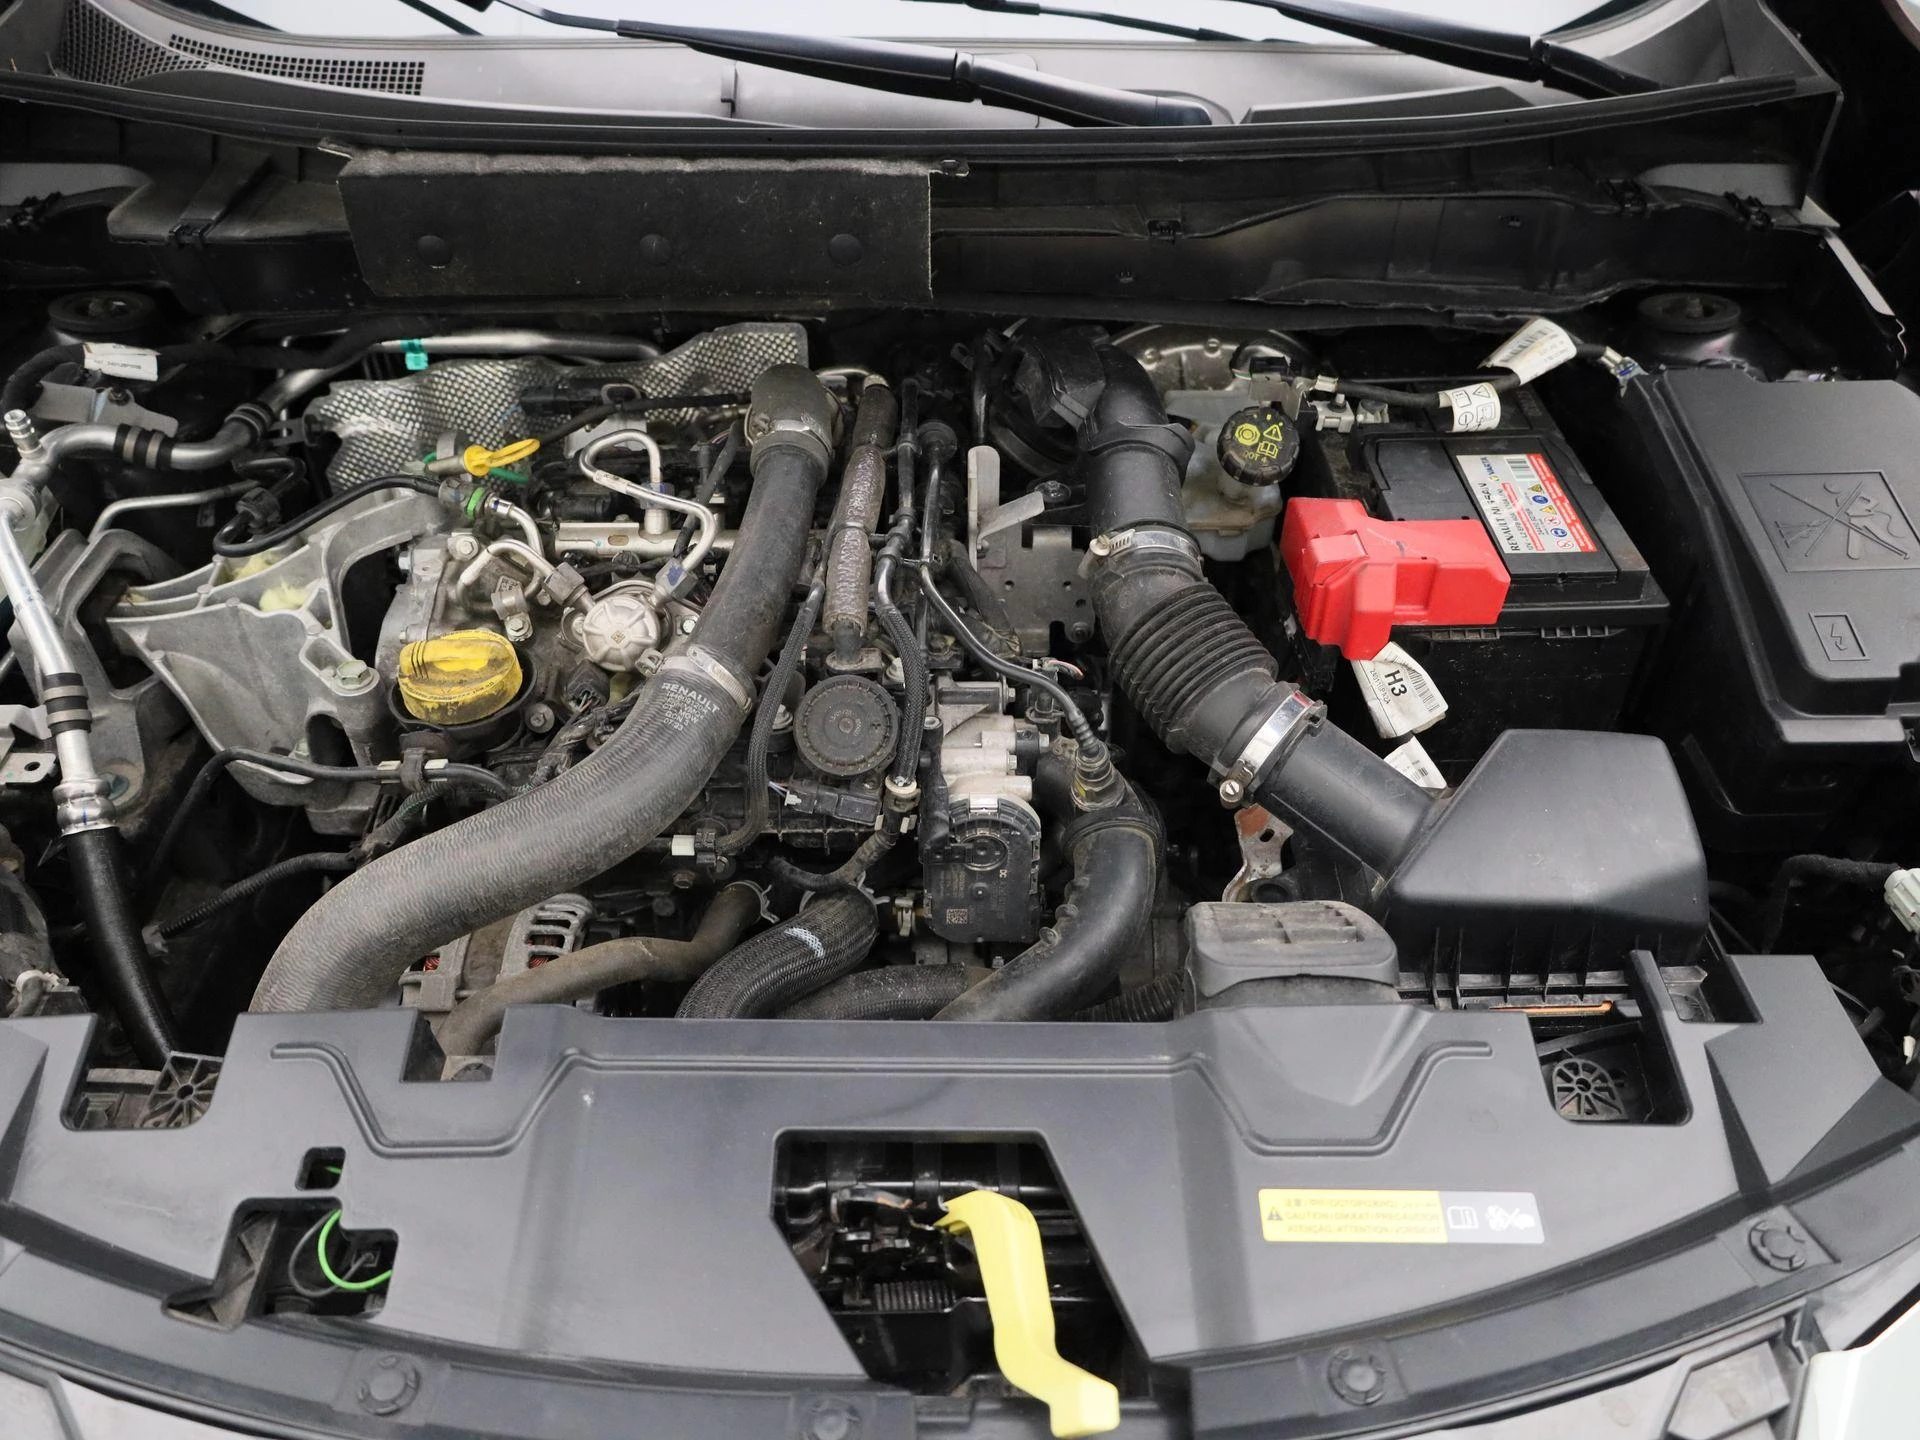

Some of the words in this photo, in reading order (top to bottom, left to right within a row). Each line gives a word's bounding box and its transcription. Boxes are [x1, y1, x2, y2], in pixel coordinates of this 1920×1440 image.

[1479, 456, 1496, 476] VARTA
[1495, 518, 1521, 551] RENAULT
[661, 682, 720, 713] RENAULT
[1384, 669, 1408, 697] H3
